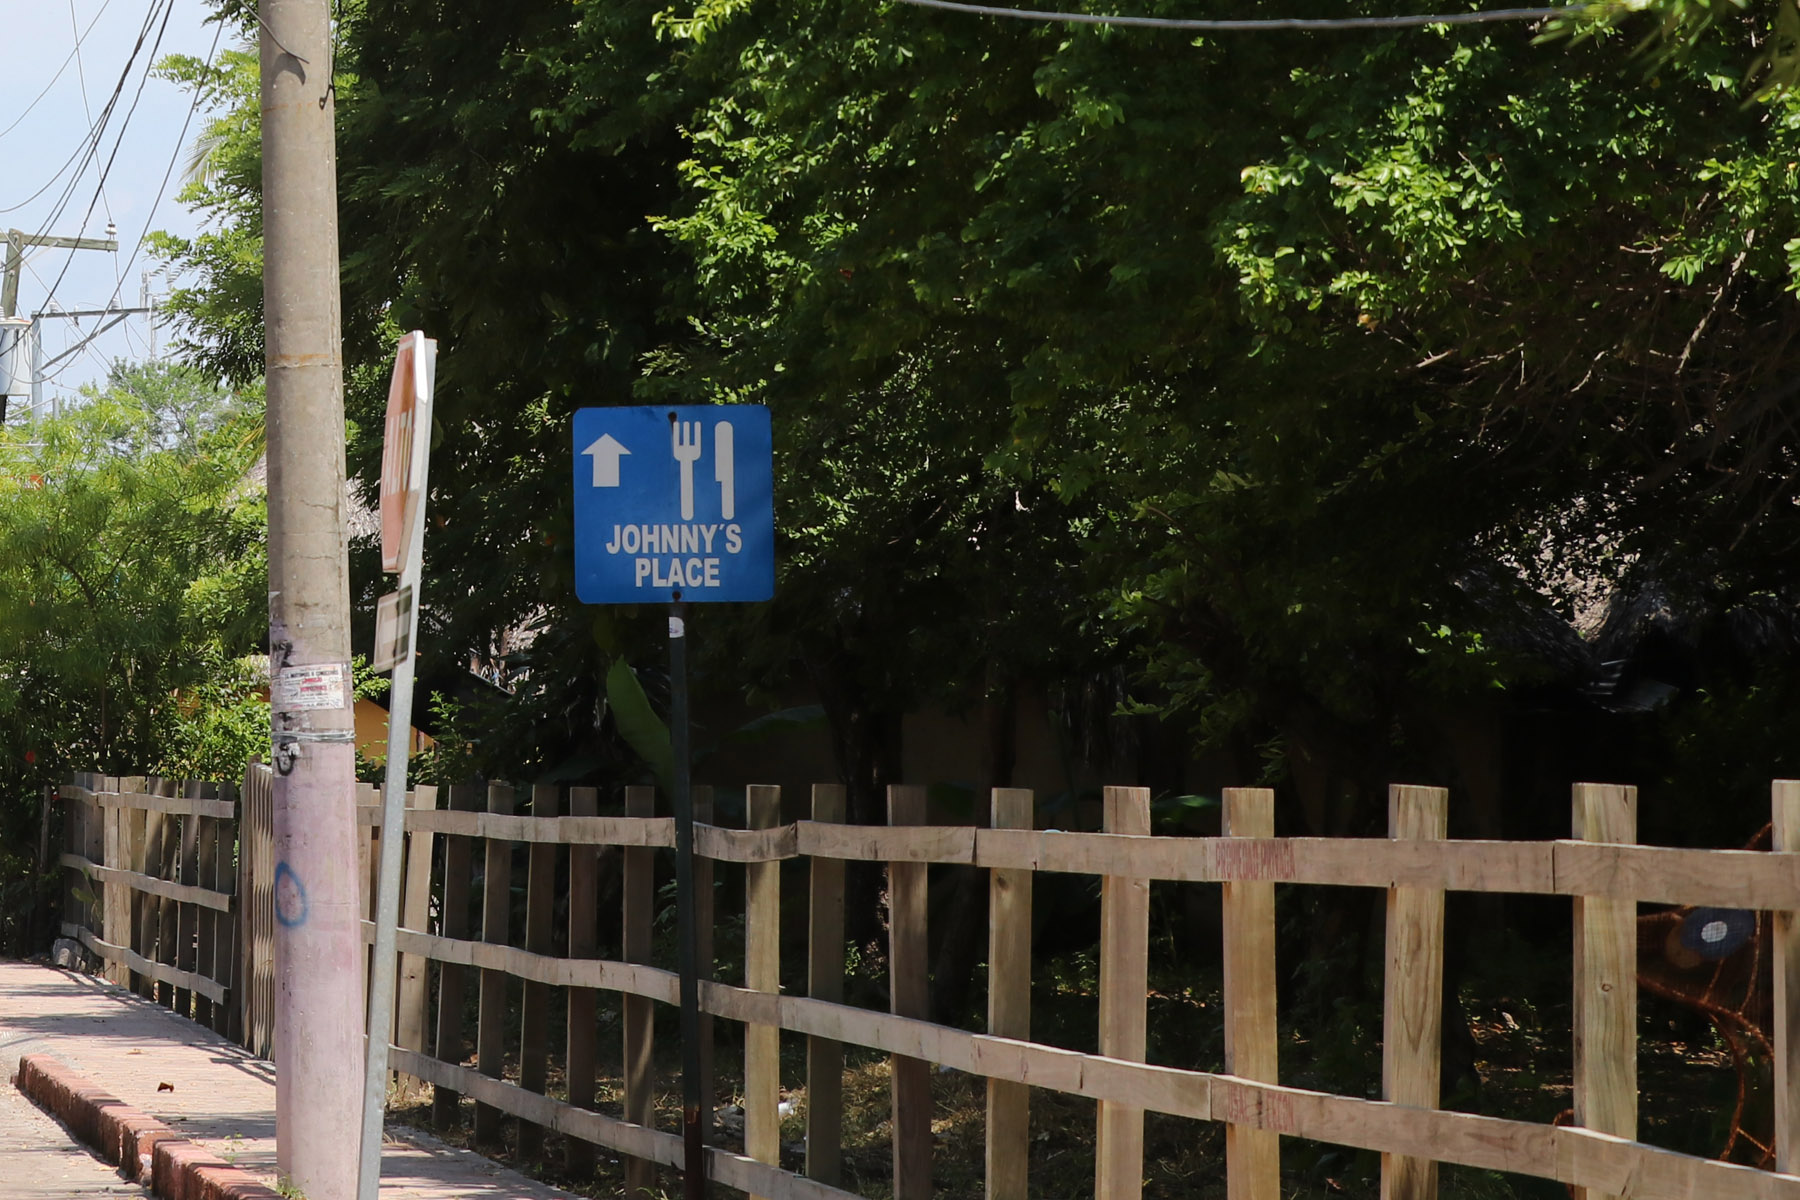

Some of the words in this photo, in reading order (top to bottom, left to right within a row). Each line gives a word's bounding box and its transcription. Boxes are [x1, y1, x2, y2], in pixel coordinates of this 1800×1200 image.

[382, 408, 413, 497] ALTO
[605, 523, 742, 555] JOHNNY'S
[635, 557, 720, 588] PLACE
